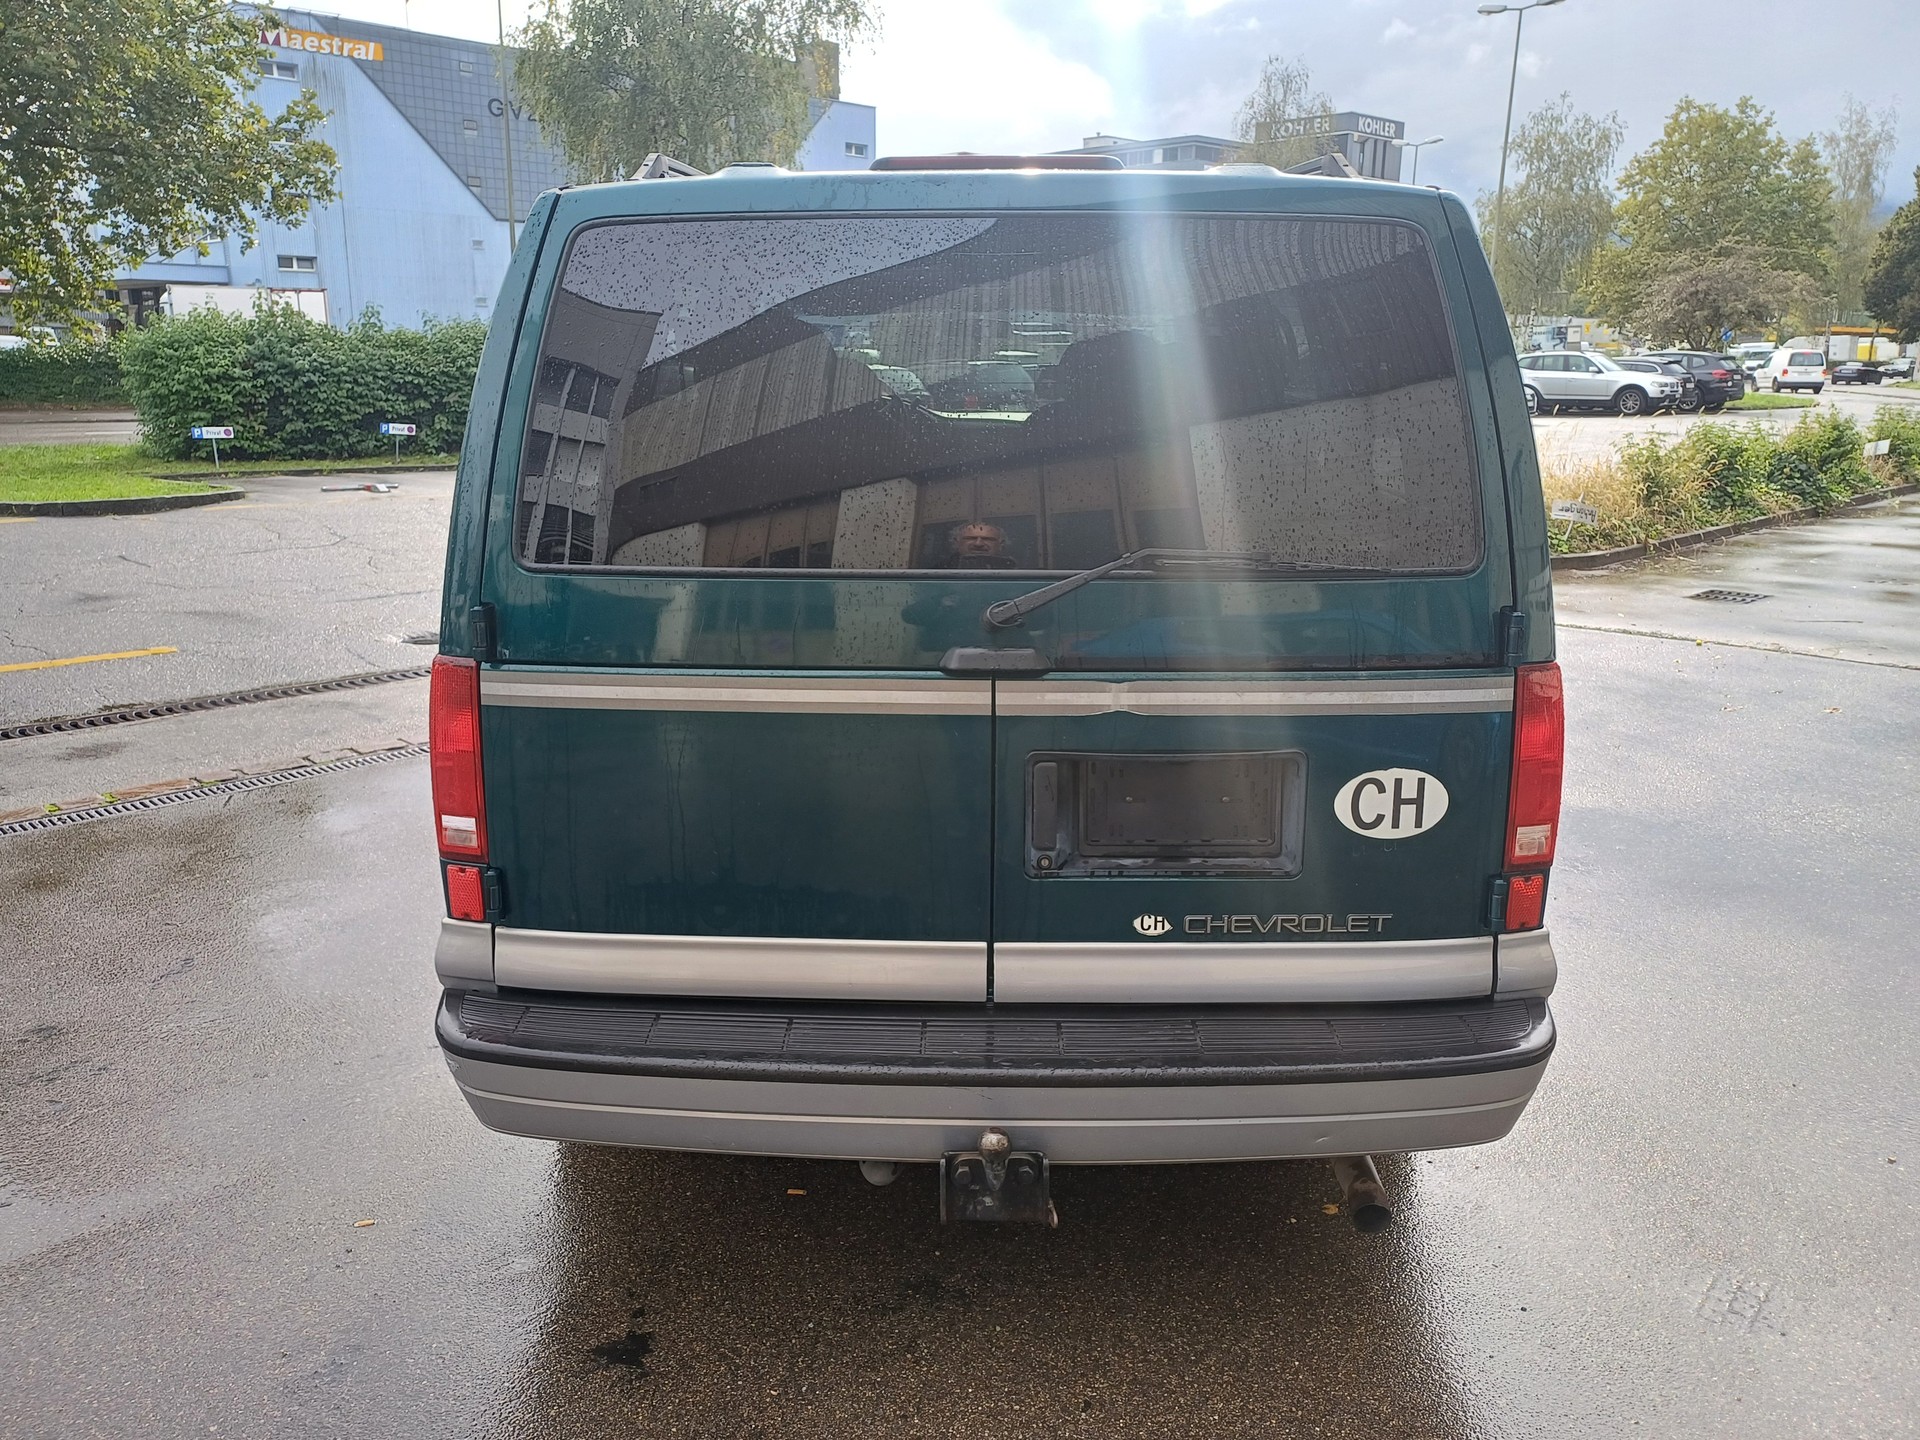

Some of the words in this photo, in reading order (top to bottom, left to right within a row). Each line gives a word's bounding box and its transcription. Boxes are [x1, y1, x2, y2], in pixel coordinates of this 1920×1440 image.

[258, 27, 375, 61] Maestral
[1358, 116, 1396, 137] KOHLER
[1350, 777, 1426, 831] CH
[1140, 914, 1166, 932] CH
[1183, 913, 1394, 935] CHEVROLET
